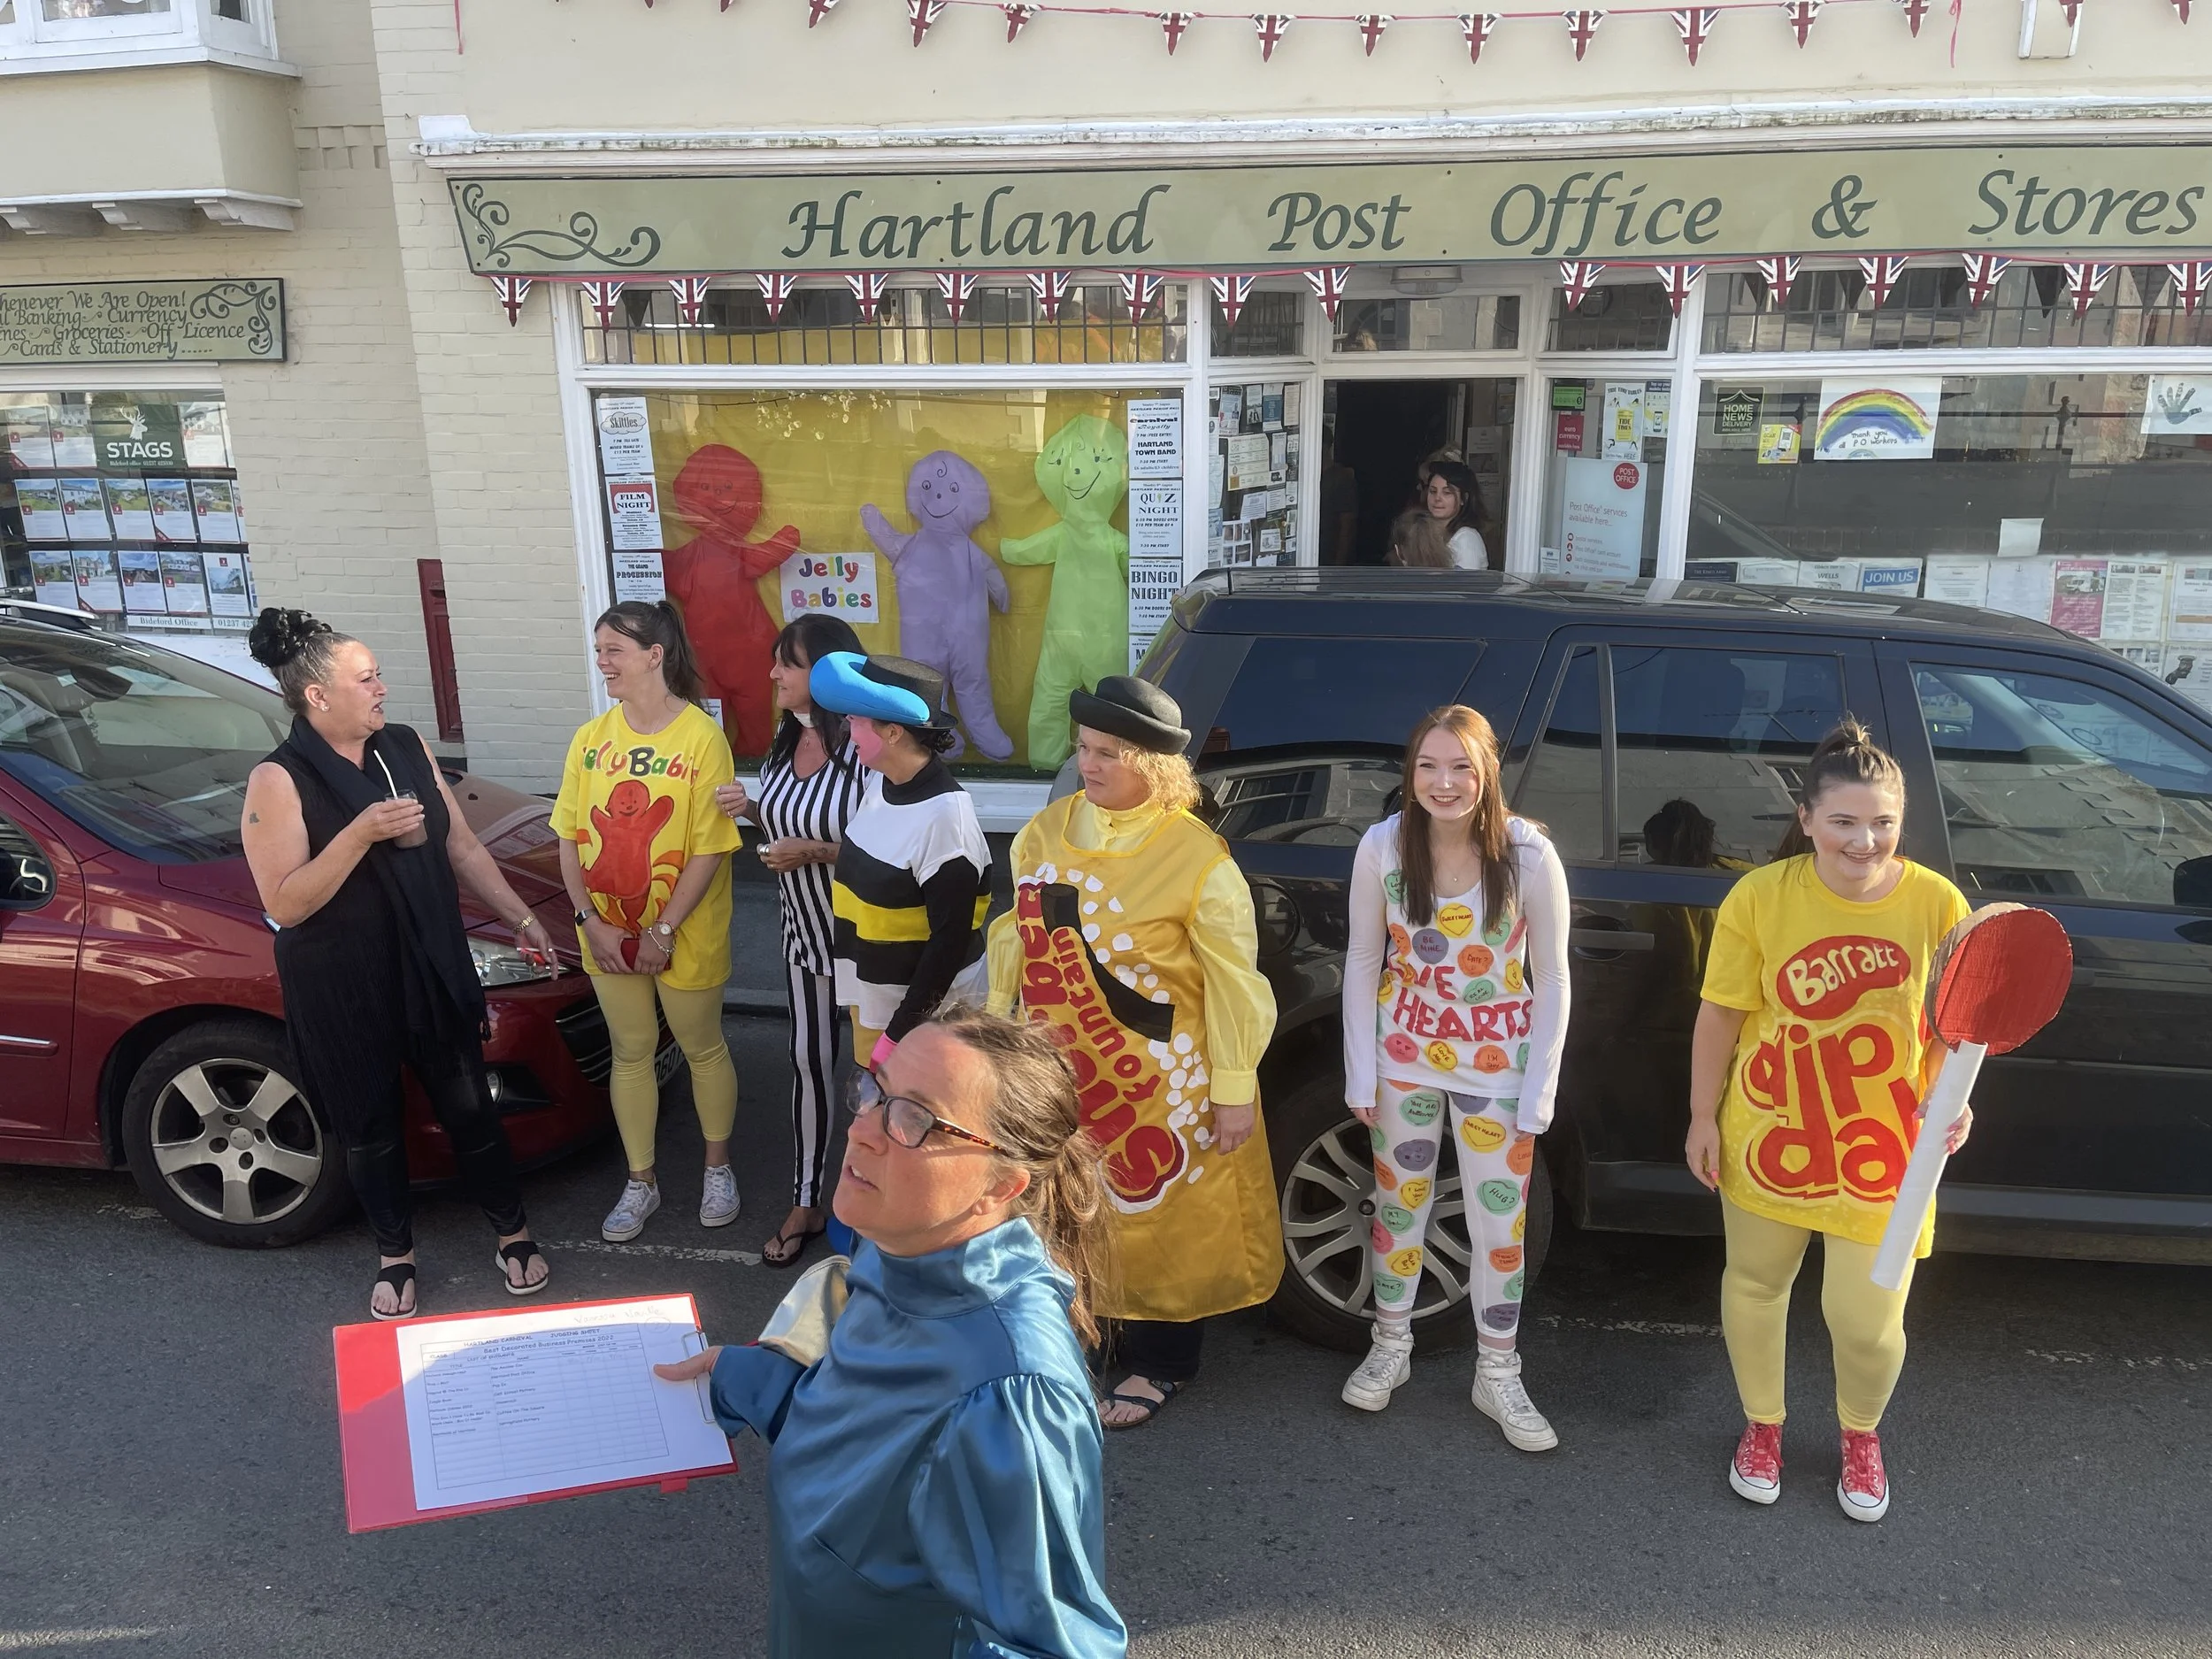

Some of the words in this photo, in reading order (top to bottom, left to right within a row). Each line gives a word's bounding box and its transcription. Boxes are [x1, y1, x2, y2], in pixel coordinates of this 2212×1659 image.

[780, 183, 1172, 259] Hartland
[1268, 190, 1410, 253] Post
[1490, 171, 1722, 257] Office
[1812, 174, 1878, 240] &
[1969, 168, 2205, 236] Stores
[0, 293, 64, 311] henever
[67, 290, 93, 309] We
[98, 291, 130, 310] Are
[137, 290, 186, 313] Open!
[14, 308, 81, 328] Banking
[108, 307, 187, 329] Currency
[0, 327, 27, 341] nes
[54, 324, 124, 343] Groceries
[147, 323, 175, 345] Off
[182, 322, 246, 339] Licence
[20, 339, 63, 357] Cards
[69, 339, 81, 356] &
[88, 338, 178, 360] Stationery
[1724, 403, 1754, 412] HOME
[610, 417, 638, 428] Skittles
[1723, 412, 1753, 421] NEWS
[1875, 431, 1888, 440] you
[106, 442, 173, 458] STAGS
[1569, 502, 1582, 511] Post
[1603, 508, 1628, 517] services
[799, 556, 859, 583] Jelly
[1131, 571, 1178, 583] BINGO
[1865, 572, 1895, 583] JOIN
[1899, 571, 1914, 582] US
[791, 587, 872, 609] Babies
[1131, 588, 1179, 600] NIGHT
[141, 617, 173, 626] Bideford
[175, 617, 198, 626] Office
[582, 740, 628, 777] elly
[1786, 943, 1900, 1006] Barratt
[1393, 987, 1532, 1041] HEARTS
[1747, 1023, 1895, 1120] dip
[1488, 1187, 1515, 1203] HUG?
[501, 1334, 533, 1343] CARNIVAL
[501, 1343, 537, 1352] Decorated
[566, 1337, 595, 1346] Premises
